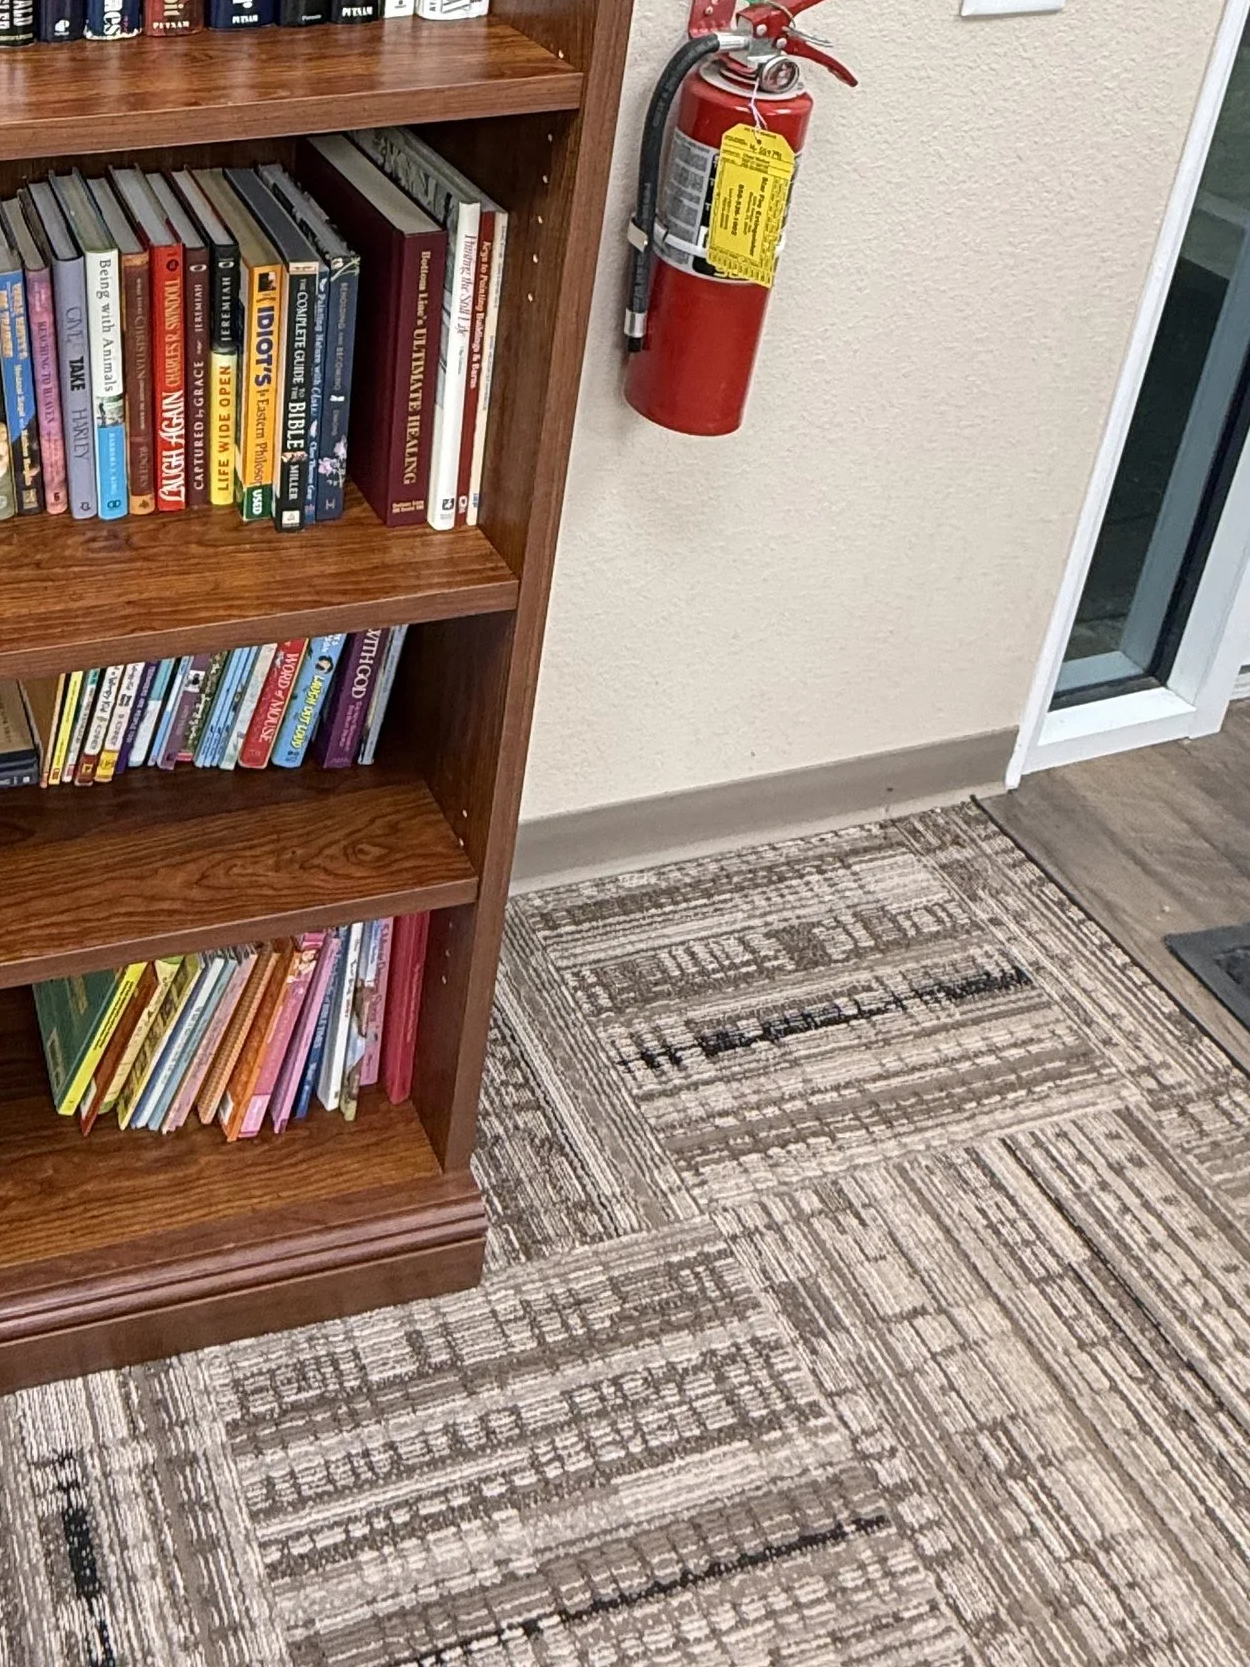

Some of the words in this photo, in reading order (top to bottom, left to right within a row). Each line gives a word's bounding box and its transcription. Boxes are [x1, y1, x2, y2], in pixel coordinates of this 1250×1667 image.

[152, 20, 190, 30] PUTNAM
[232, 15, 258, 24] PUTNAM
[342, 6, 372, 17] PUTNAM
[481, 242, 491, 262] Keys
[481, 264, 489, 274] to
[97, 259, 111, 299] Being
[475, 276, 488, 311] Painting
[101, 301, 115, 333] with
[166, 278, 181, 332] SWINDOLL
[194, 284, 203, 332] JEREMIAH
[221, 277, 231, 341] JEREMIAH
[255, 306, 274, 386] IDIOT'S
[69, 356, 85, 391] TAKE
[103, 336, 120, 392] Animals
[409, 328, 426, 411] ULTIMATE
[196, 361, 204, 407] GRACE
[219, 365, 231, 406] OPEN
[72, 409, 89, 460] HARLEY
[158, 390, 185, 446] AGAIN
[218, 418, 230, 454] WIDE
[403, 414, 421, 485] HEALING
[193, 421, 204, 489] CAPTURED
[159, 451, 186, 502] LAUGH
[219, 459, 229, 491] LIFE
[288, 465, 300, 500] MILLER
[252, 489, 263, 515] USED
[360, 630, 381, 664] WITH
[279, 653, 299, 687] WORD
[351, 665, 372, 699] GOD
[306, 676, 326, 706] LAUGH
[259, 698, 285, 743] MOUSE
[300, 706, 314, 725] OUT
[291, 724, 308, 749] LOUD
